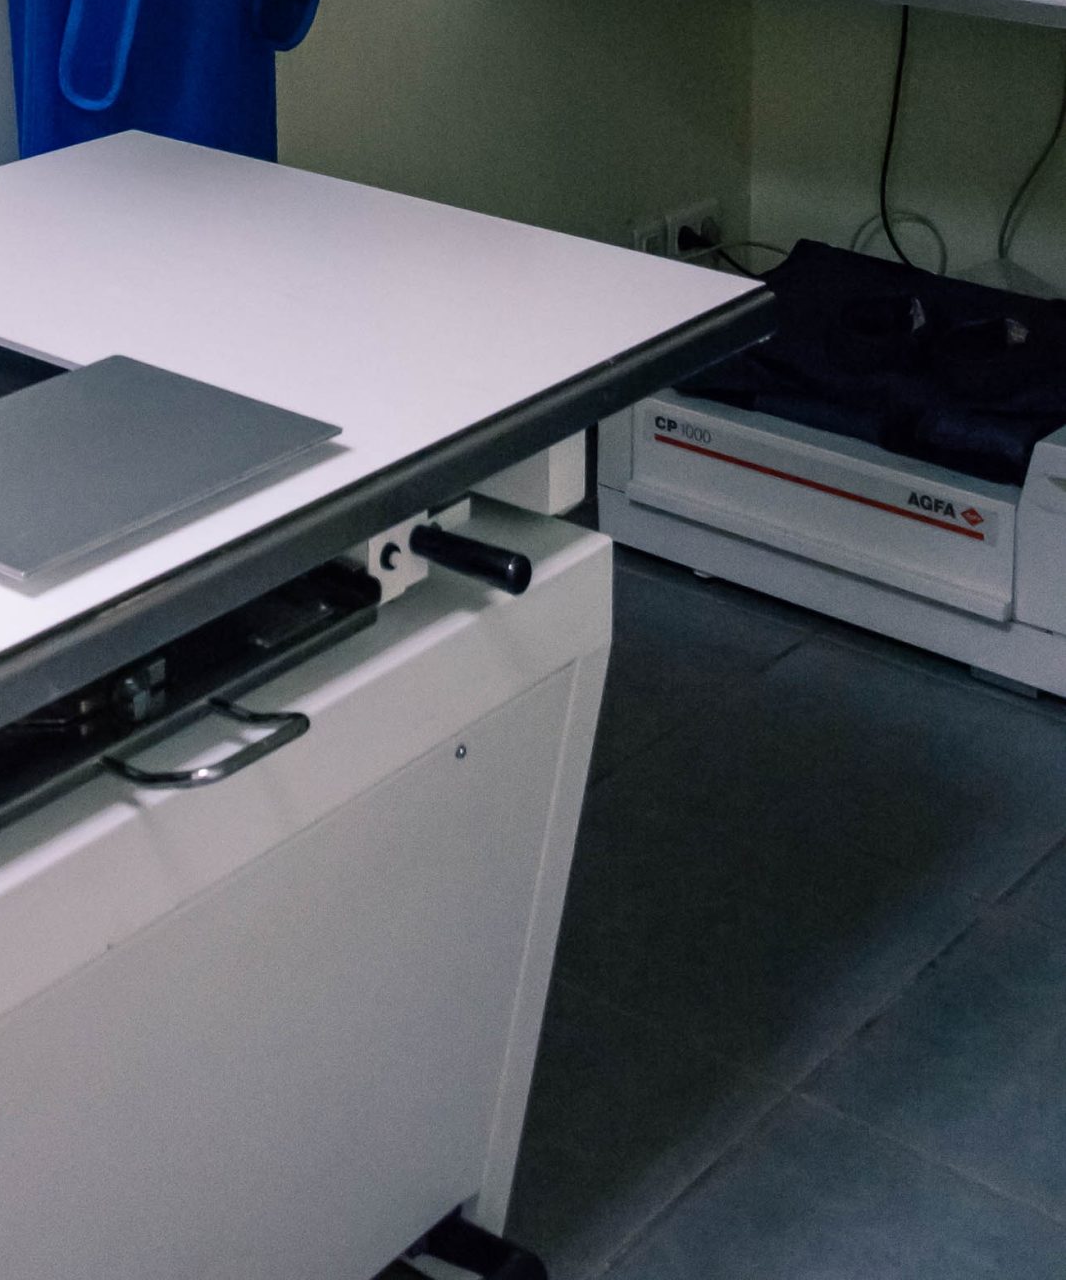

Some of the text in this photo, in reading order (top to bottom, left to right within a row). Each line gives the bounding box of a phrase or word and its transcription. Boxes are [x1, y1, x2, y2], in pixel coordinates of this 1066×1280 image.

[655, 415, 711, 444] CP 1000
[908, 491, 956, 519] AGFA
